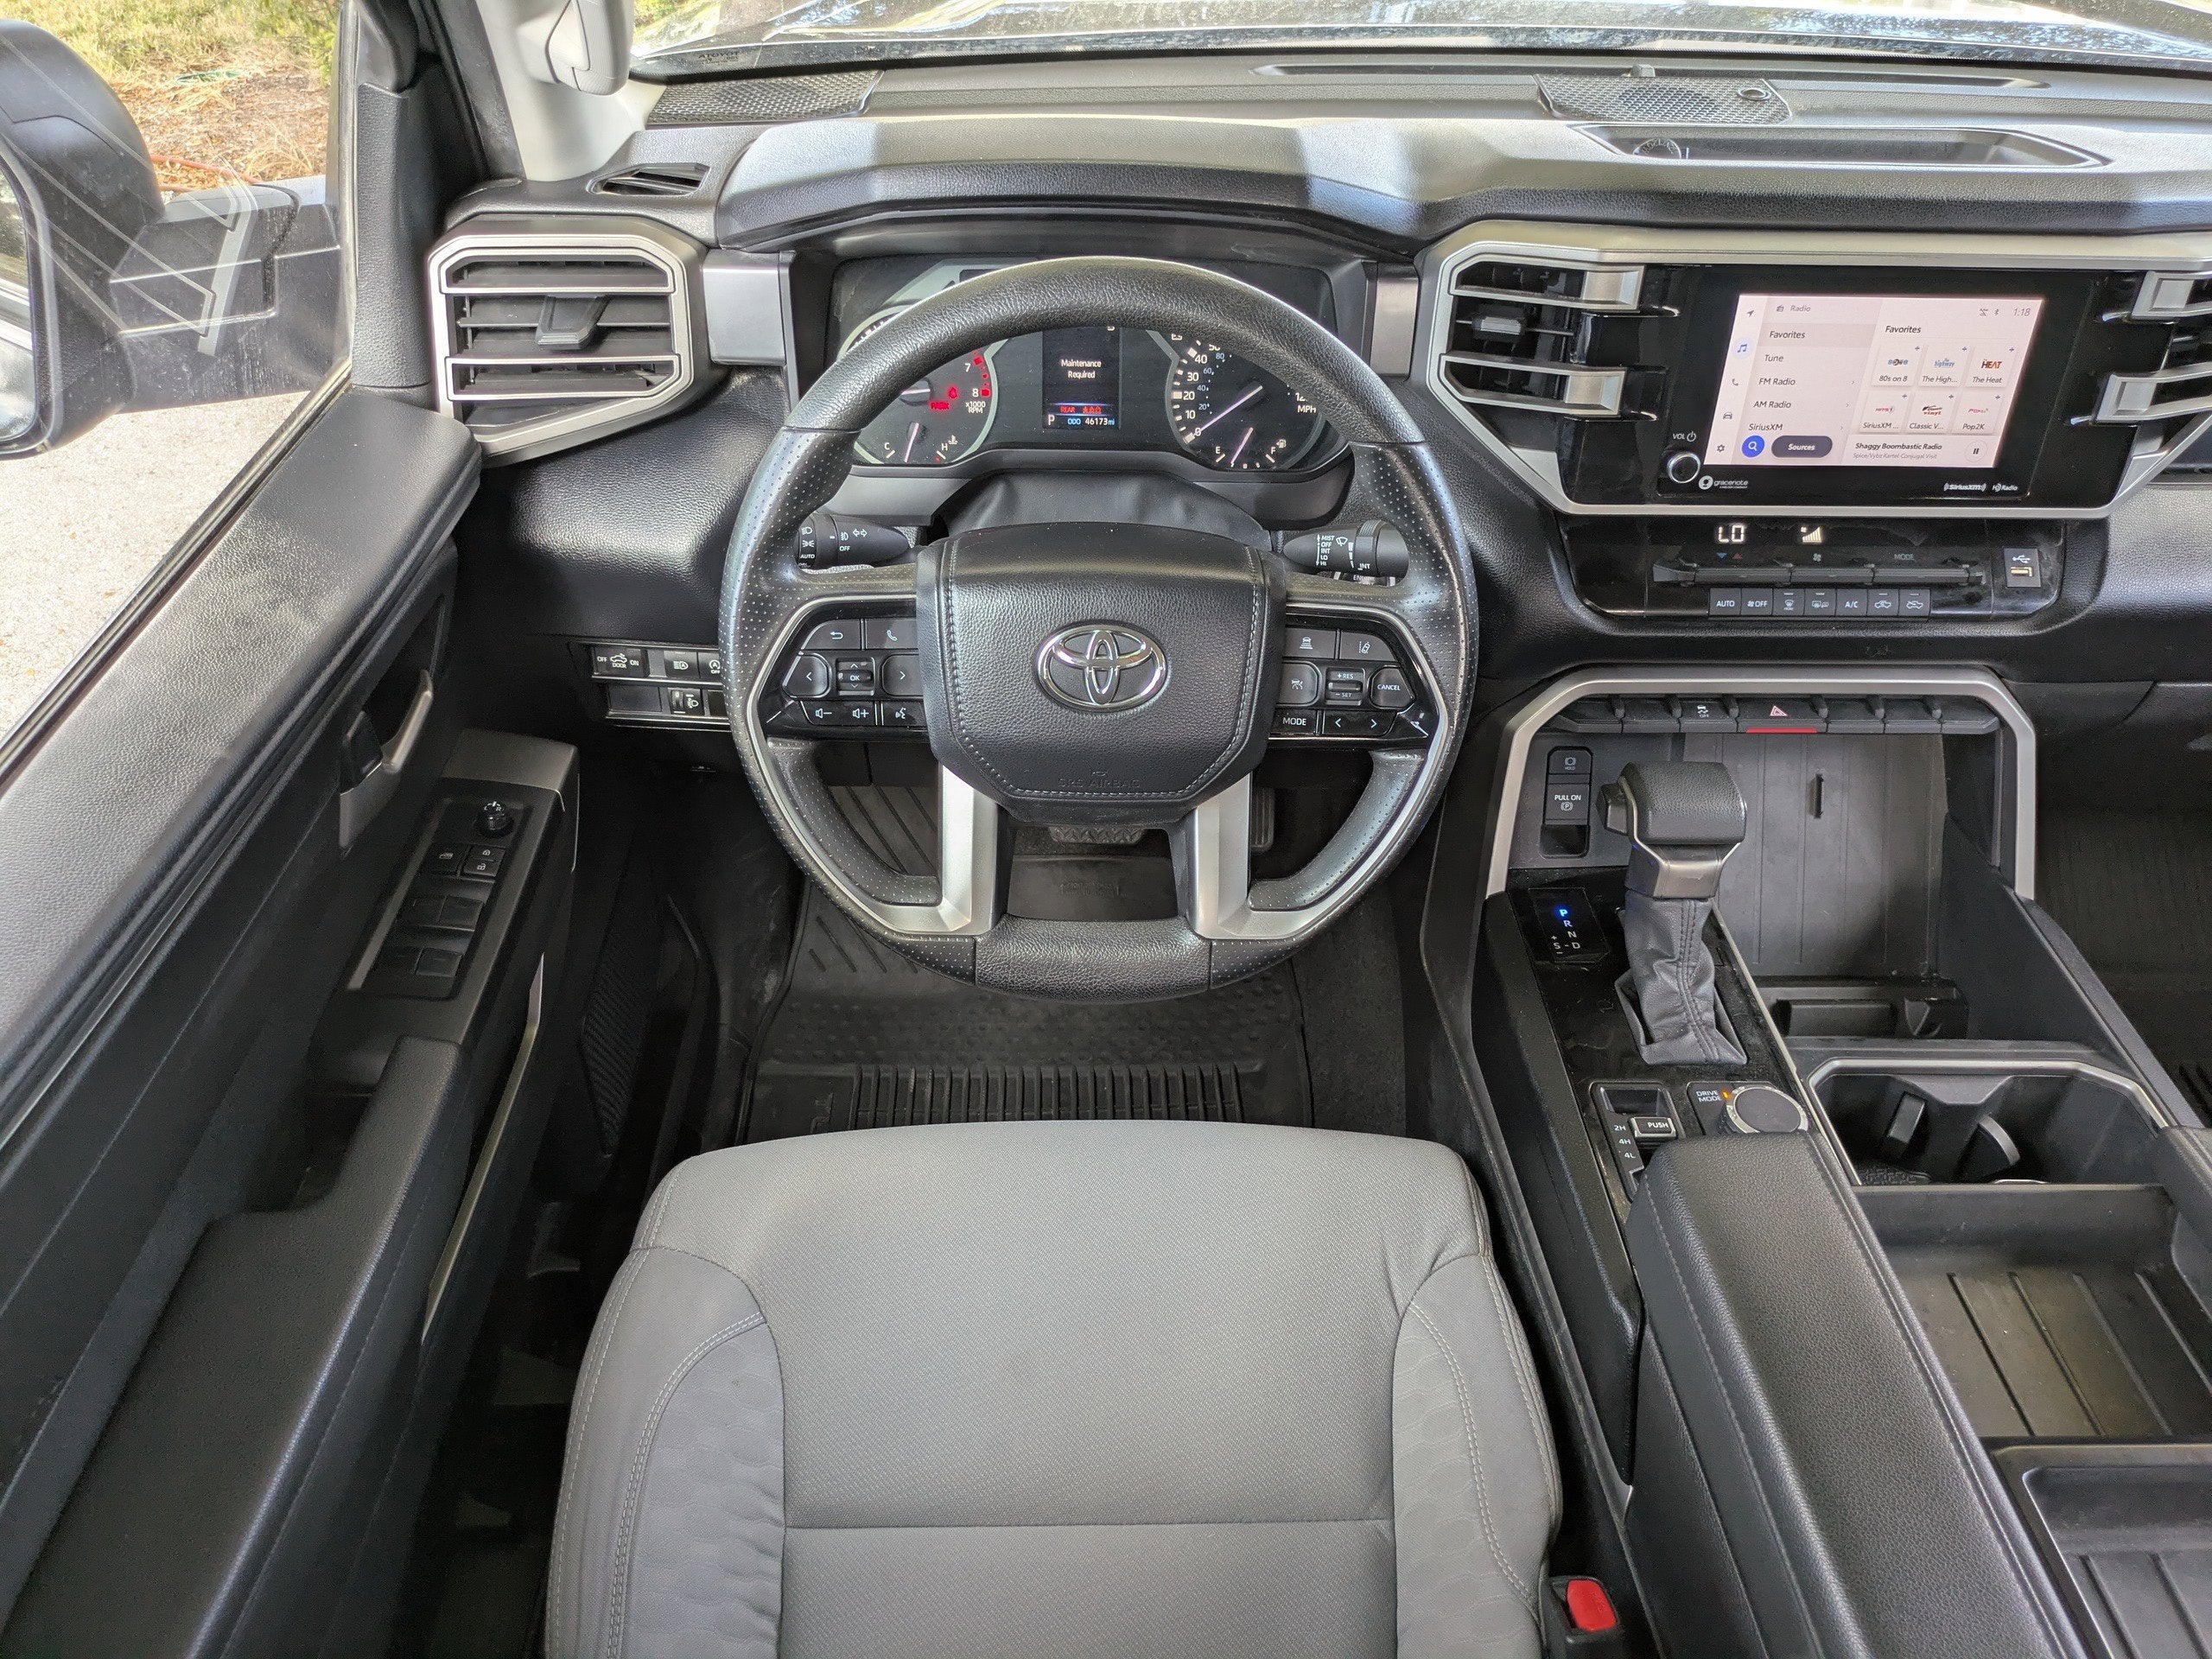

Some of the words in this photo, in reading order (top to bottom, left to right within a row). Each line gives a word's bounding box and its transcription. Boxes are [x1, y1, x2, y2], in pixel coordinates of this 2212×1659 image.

[2013, 308, 2031, 316] 1:18
[1885, 325, 1922, 334] Favorites
[1769, 330, 1806, 339] Favorites
[1060, 359, 1102, 367] Maintenance
[1194, 354, 1207, 365] 40
[964, 363, 971, 372] 7
[1186, 372, 1199, 382] 30
[972, 388, 979, 397] 8
[1183, 391, 1195, 400] 20
[1769, 400, 1791, 409] Radio
[1185, 410, 1196, 419] 10
[1047, 414, 1055, 425] P
[1748, 423, 1783, 431] SiriusXM
[1718, 525, 1745, 543] LO
[1282, 717, 1306, 726] MODE
[1647, 1121, 1669, 1129] PUSH
